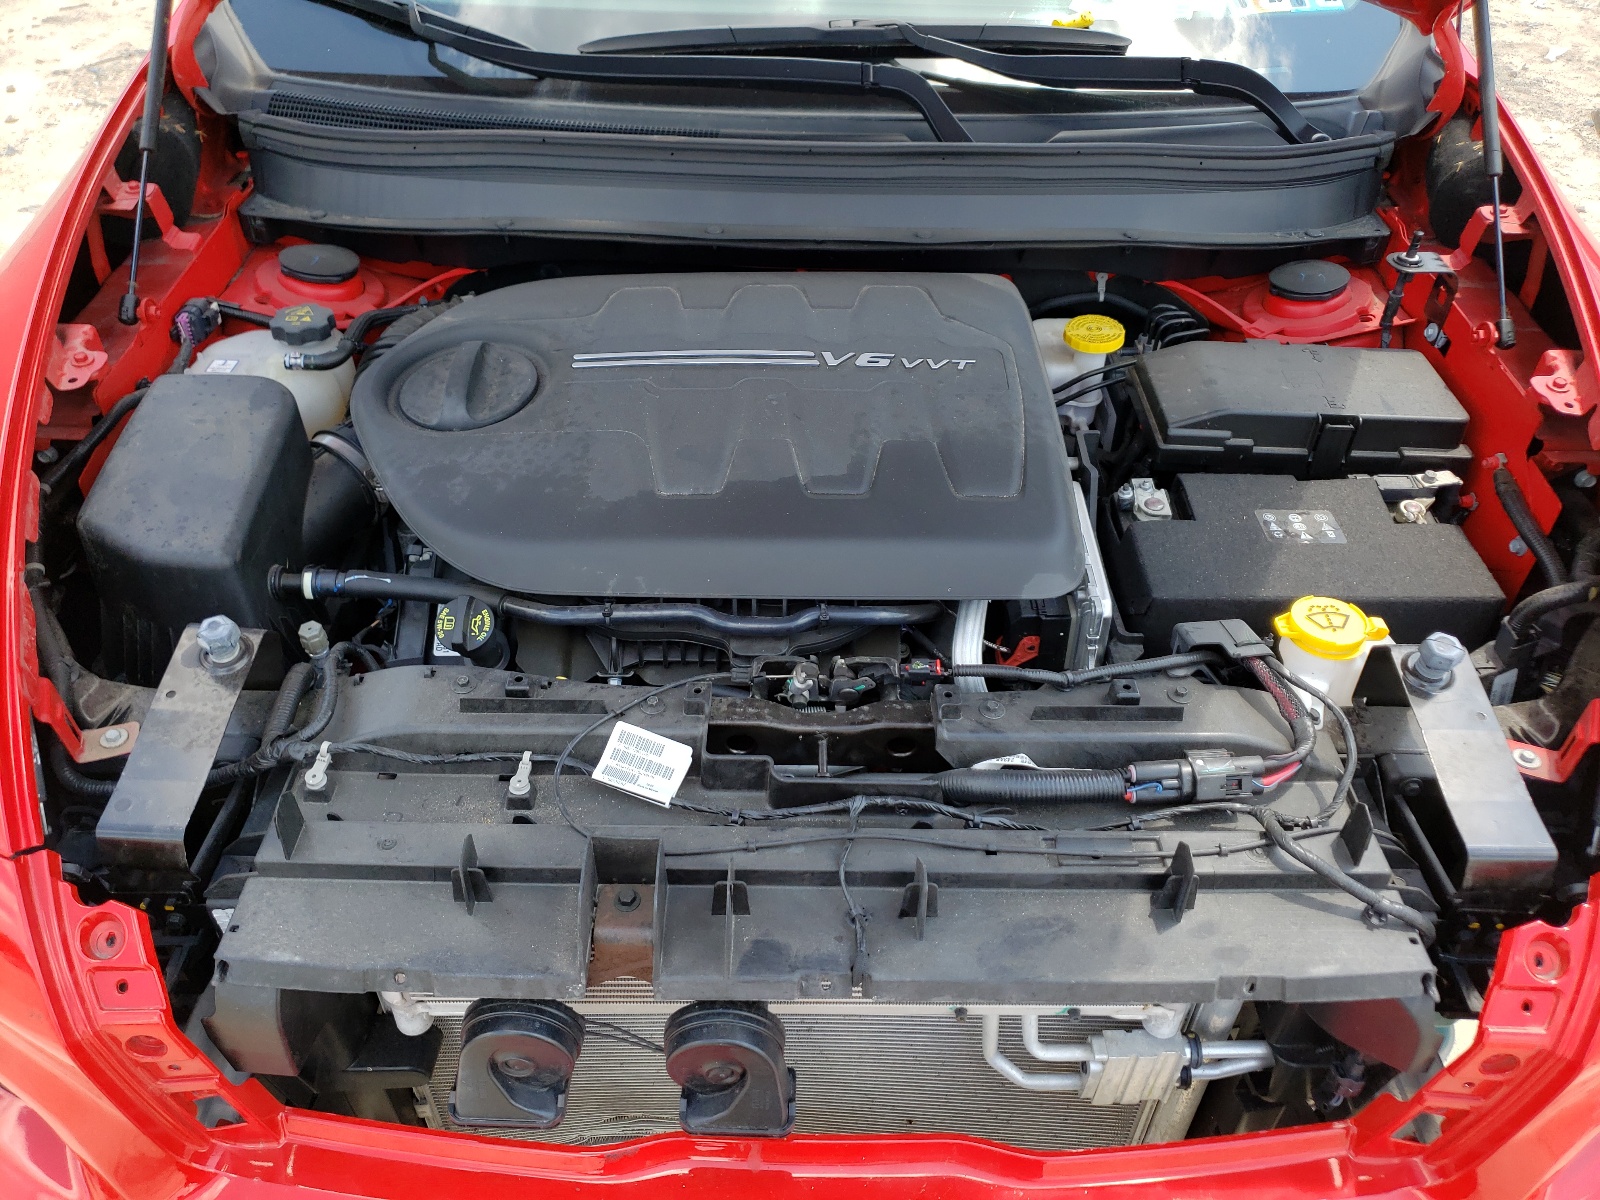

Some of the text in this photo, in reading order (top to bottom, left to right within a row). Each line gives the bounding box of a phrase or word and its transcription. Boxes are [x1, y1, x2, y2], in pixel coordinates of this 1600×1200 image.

[821, 351, 977, 370] V6 VVT
[477, 609, 490, 641] ENGINE OIL
